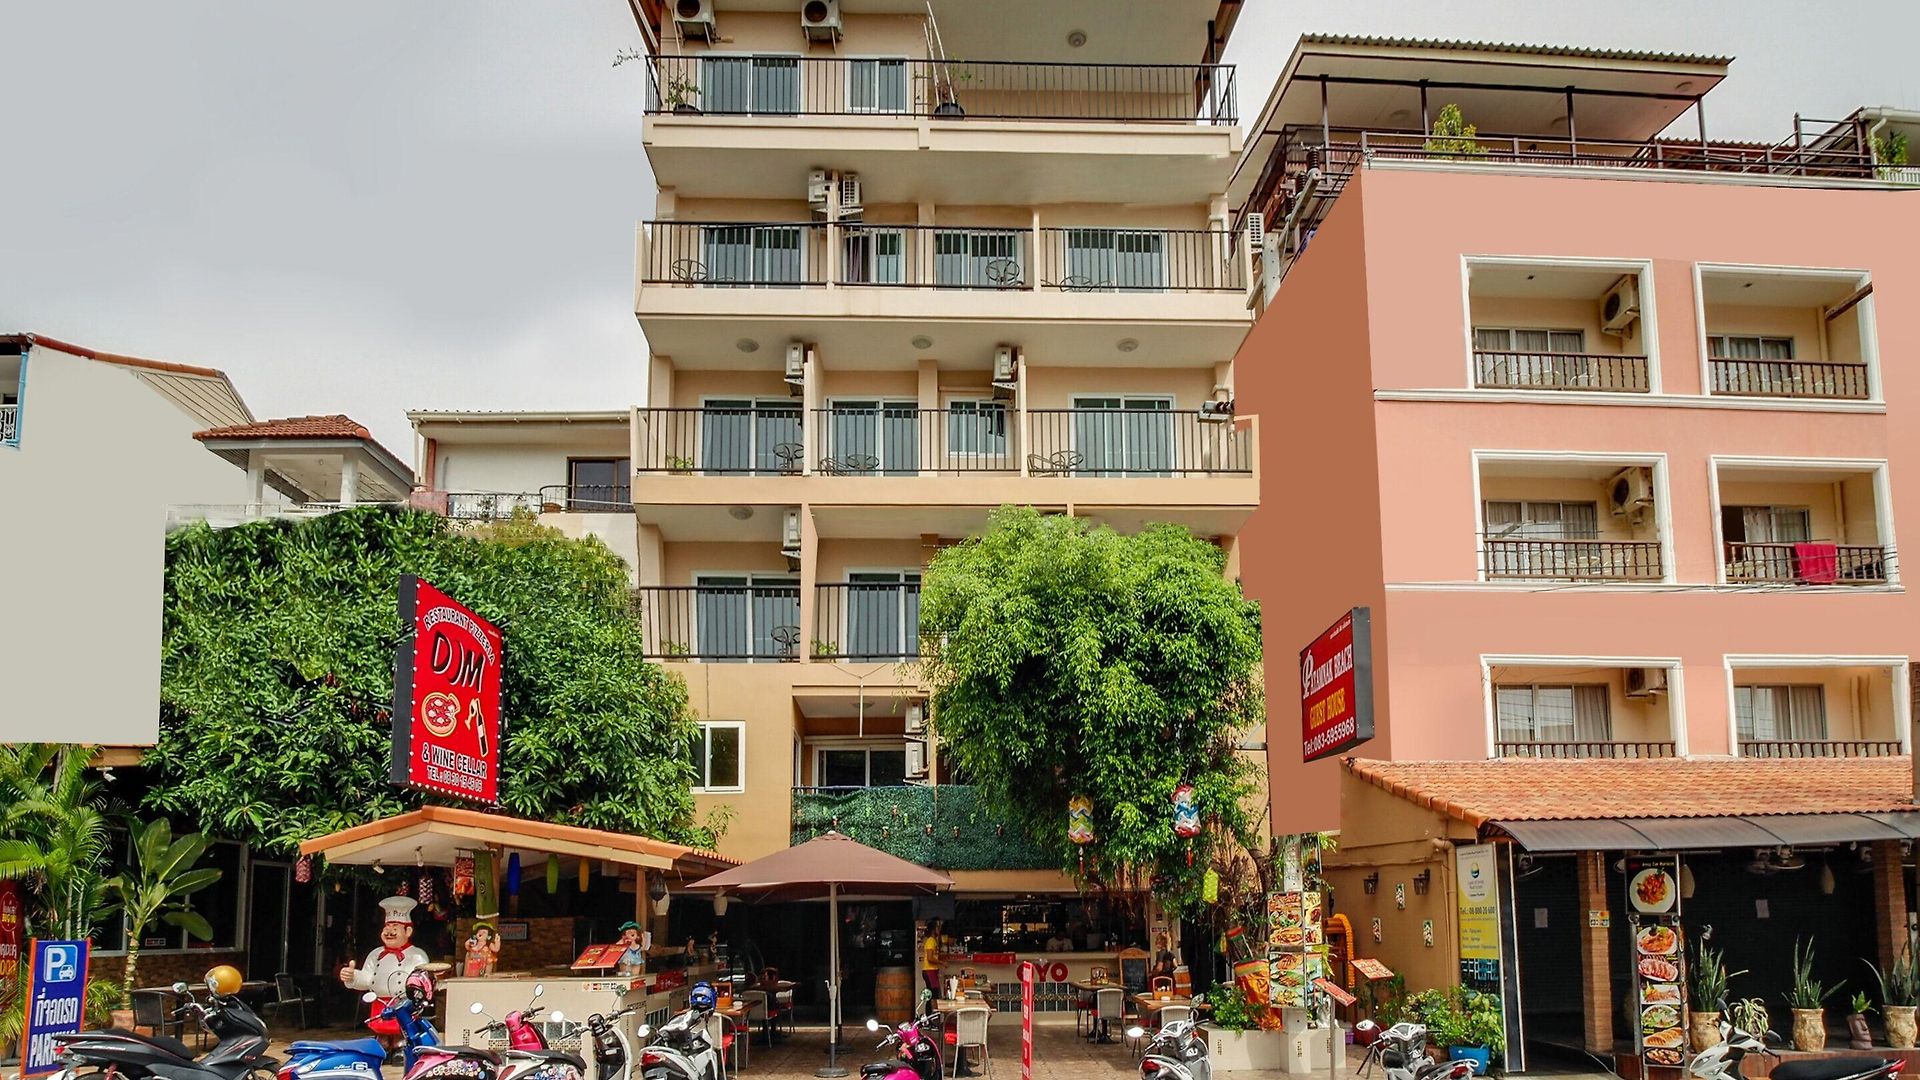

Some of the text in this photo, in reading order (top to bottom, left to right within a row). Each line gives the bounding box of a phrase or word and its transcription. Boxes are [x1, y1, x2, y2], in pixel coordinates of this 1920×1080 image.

[423, 606, 496, 666] RESTAURANT PIZZERIA
[431, 630, 486, 693] DJM
[1333, 643, 1353, 679] BEACH
[1310, 687, 1346, 730] GUEST HOUSE
[421, 742, 488, 780] & WINE CELLAR
[34, 987, 78, 1027] ที่จอดรถ
